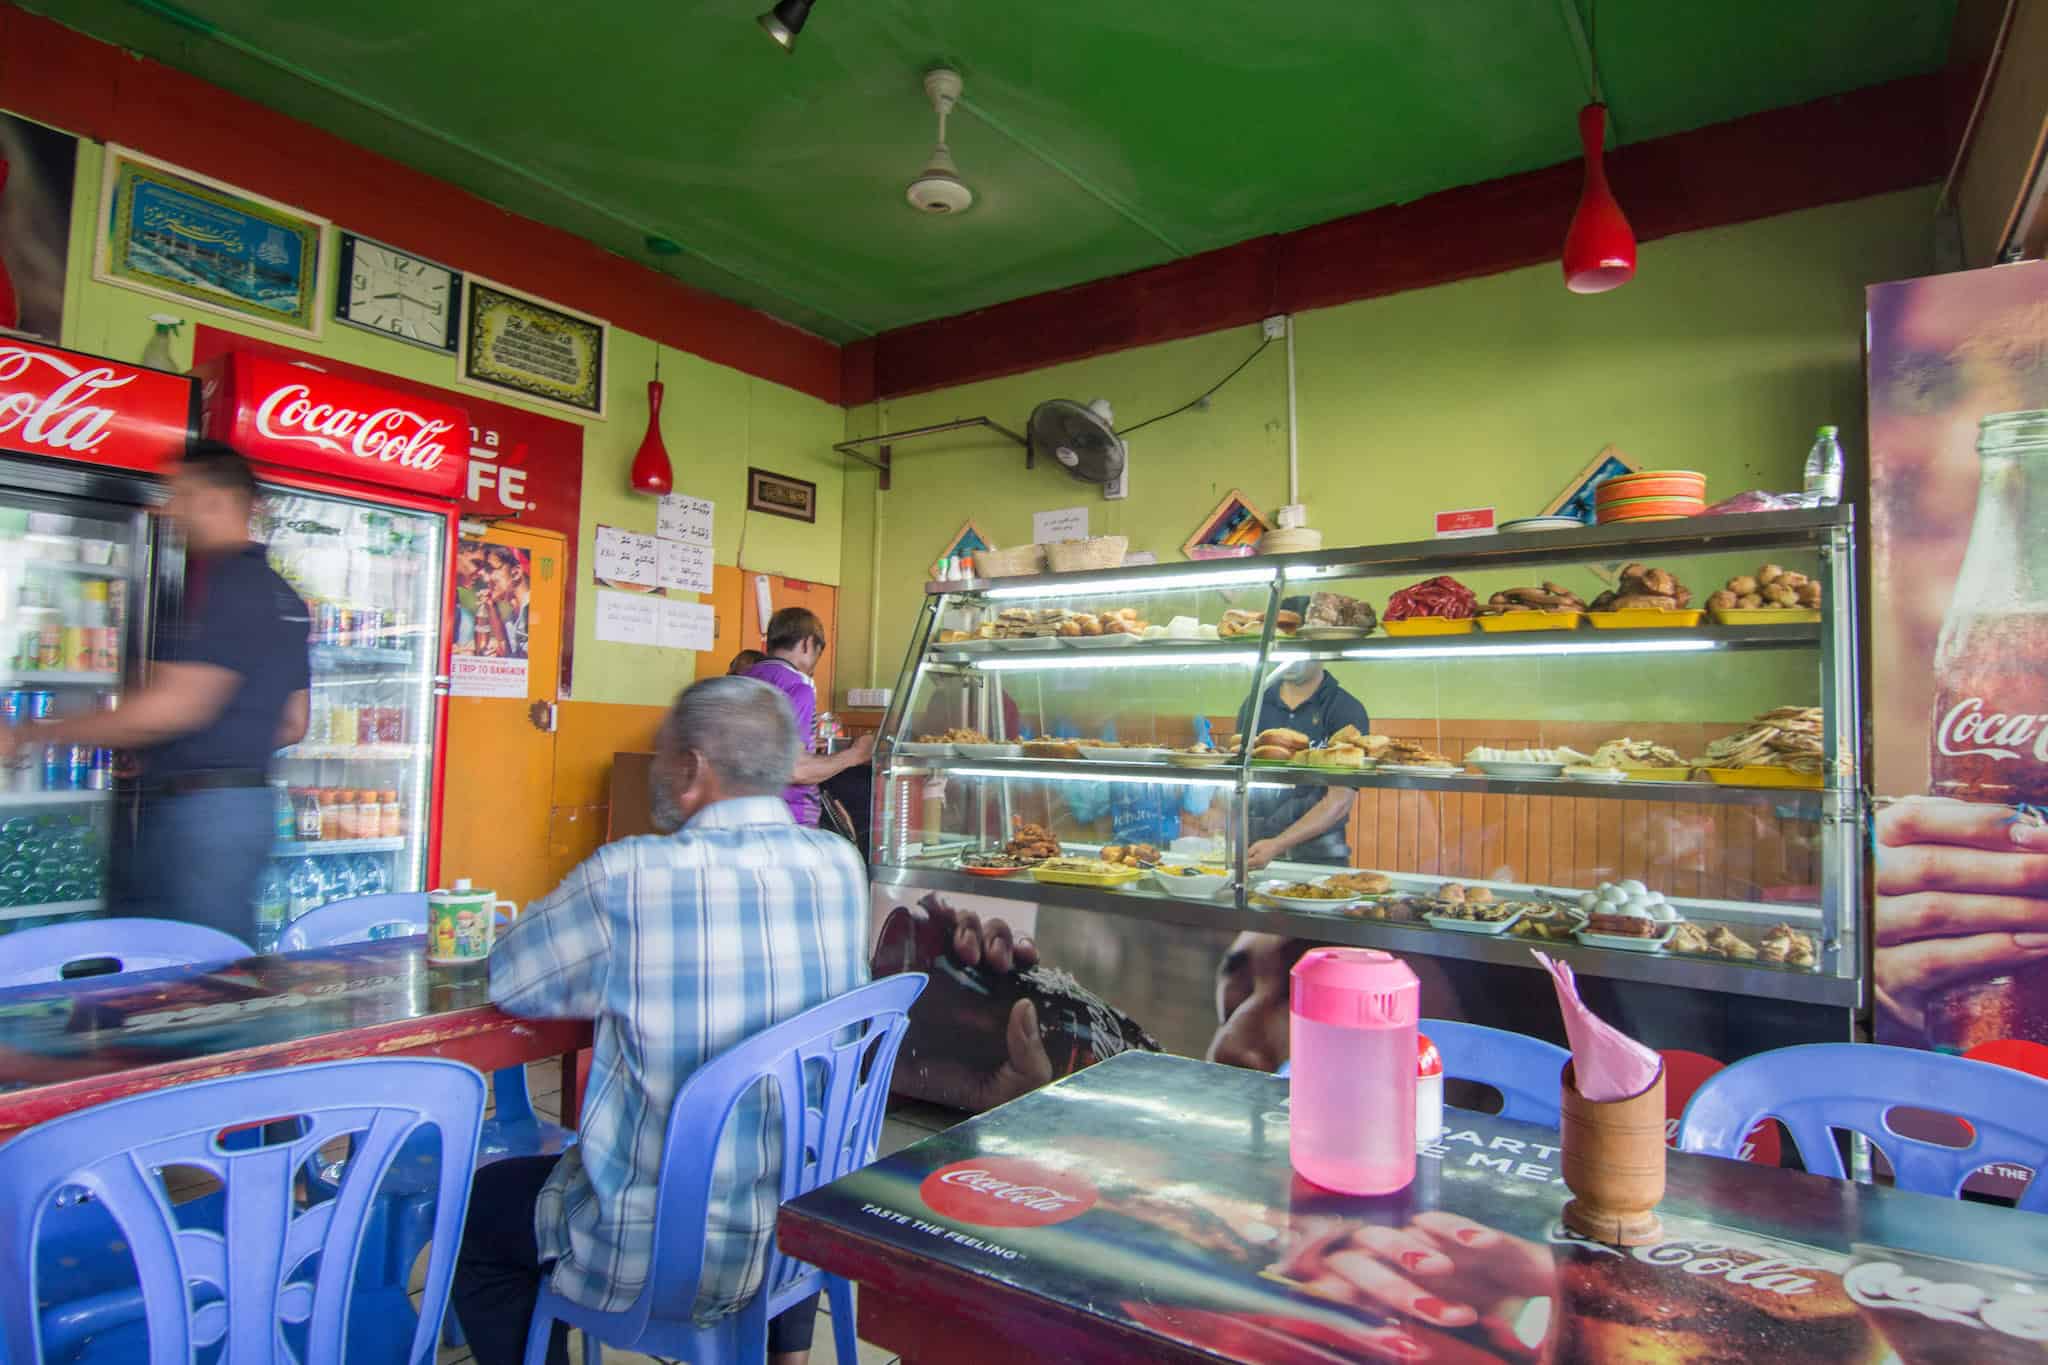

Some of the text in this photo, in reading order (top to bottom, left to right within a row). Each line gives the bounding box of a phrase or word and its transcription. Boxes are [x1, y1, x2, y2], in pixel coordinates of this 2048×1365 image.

[394, 256, 409, 275] 12
[354, 274, 367, 291] 9
[256, 384, 455, 471] Coca-Cola
[466, 460, 537, 512] FE.
[480, 664, 488, 674] TO
[1998, 1166, 2028, 1181] THE
[940, 1169, 1081, 1212] Coca-Cola
[861, 1203, 1019, 1260] TASTE THE FEELING
